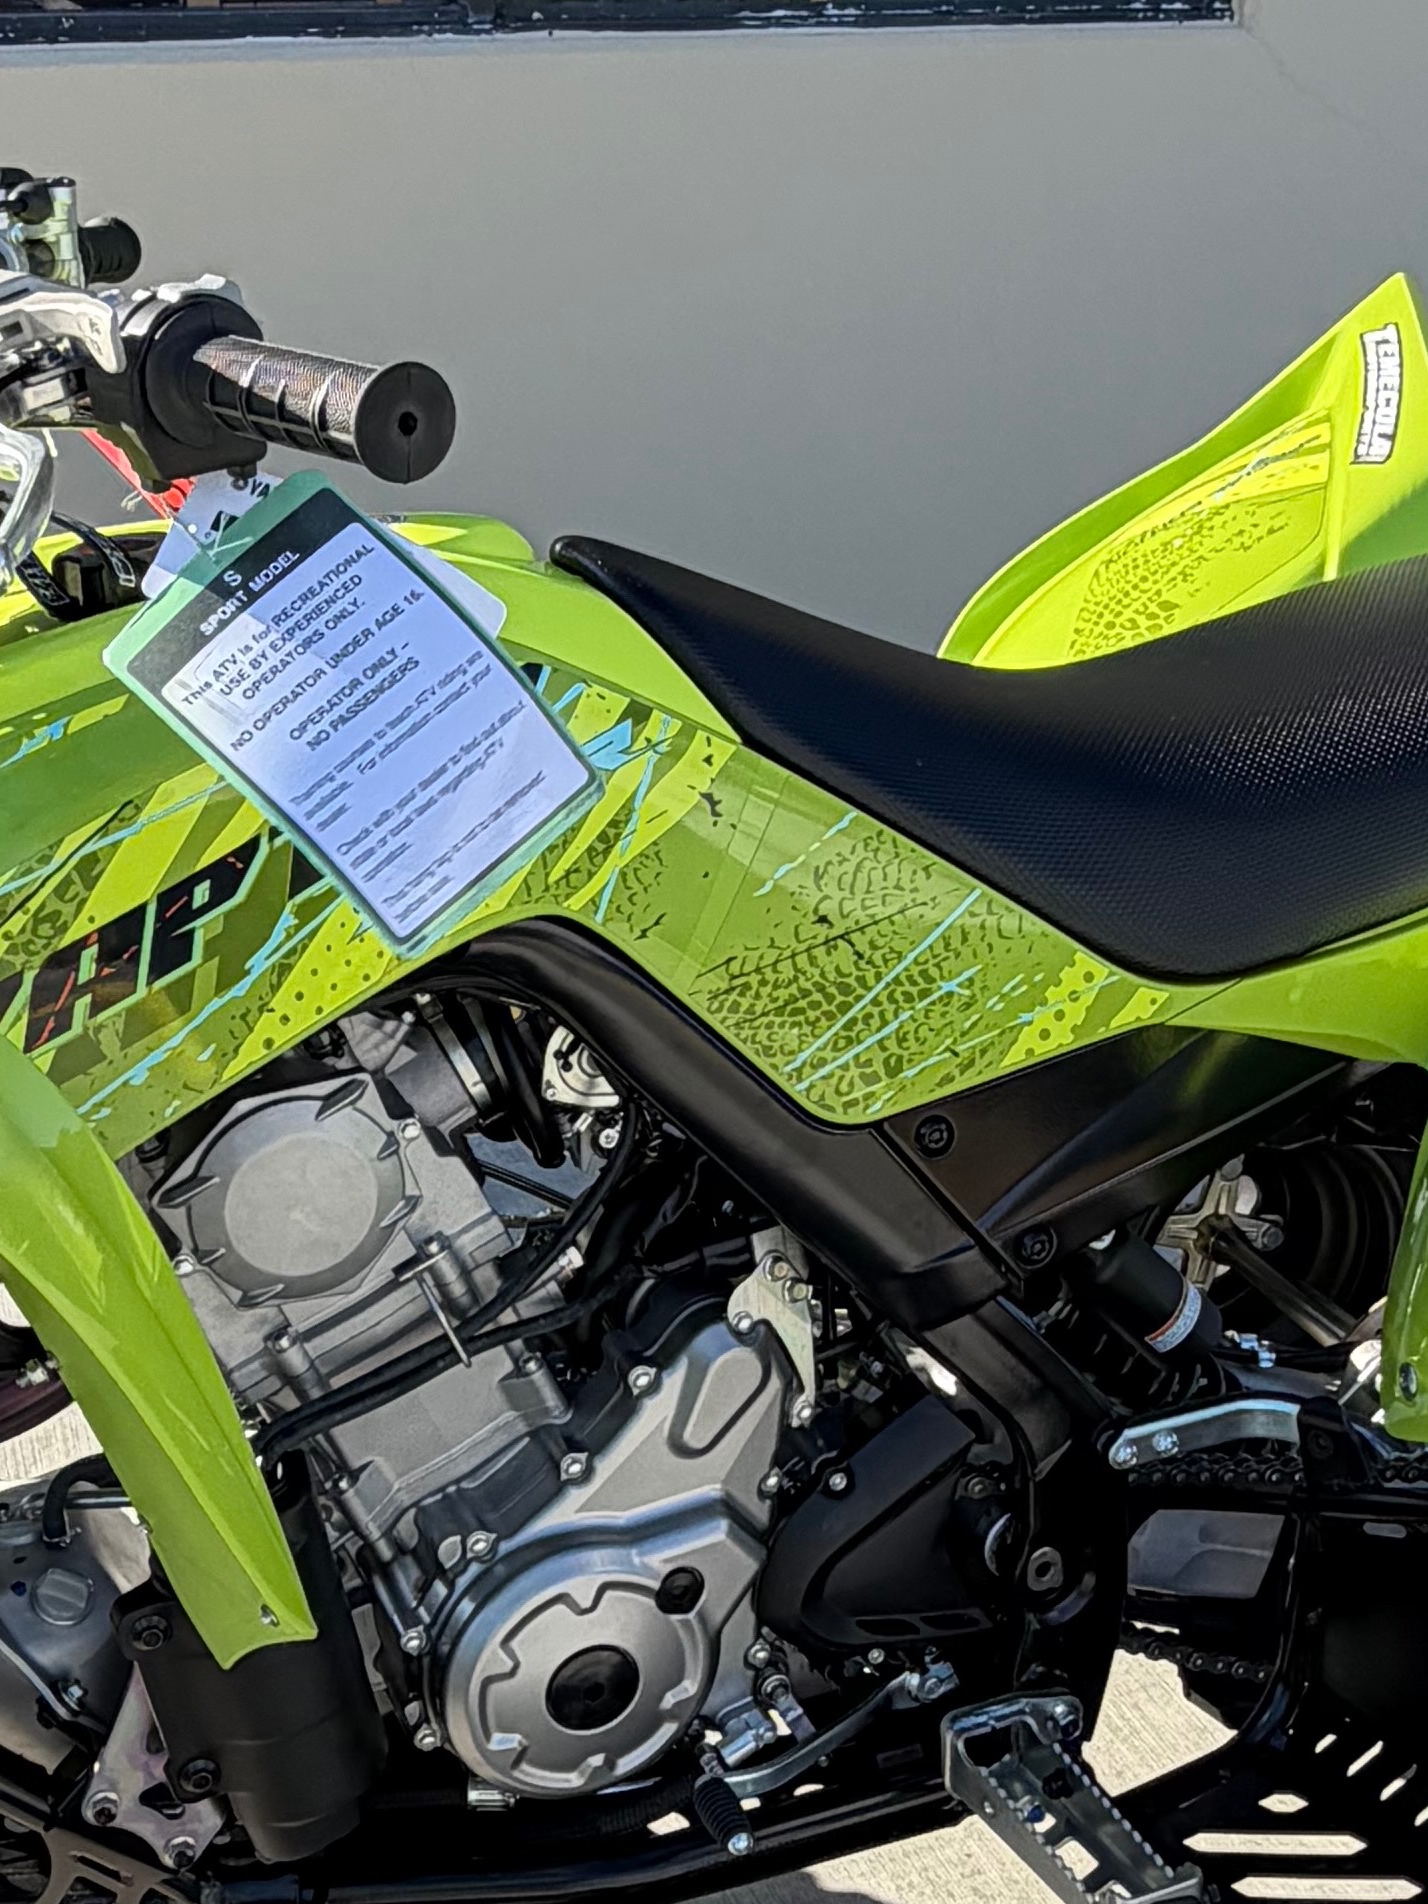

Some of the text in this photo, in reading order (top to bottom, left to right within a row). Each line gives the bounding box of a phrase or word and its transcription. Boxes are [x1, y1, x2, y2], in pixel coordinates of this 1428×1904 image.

[180, 536, 375, 708] This ATV is for RECREATIONAL
[197, 544, 301, 637] SPORT MODEL
[220, 566, 244, 589] S
[217, 569, 364, 698] USE BY EXPERIENCED
[228, 727, 255, 752] NO
[250, 664, 328, 733] OPERATOR
[323, 624, 376, 671] UNDER
[371, 600, 406, 632] AGE
[239, 593, 366, 703] OPERATORS ONLY.
[286, 674, 365, 743] OPERATOR
[359, 644, 401, 682] ONLY
[304, 652, 421, 752] NO PASSENGERS
